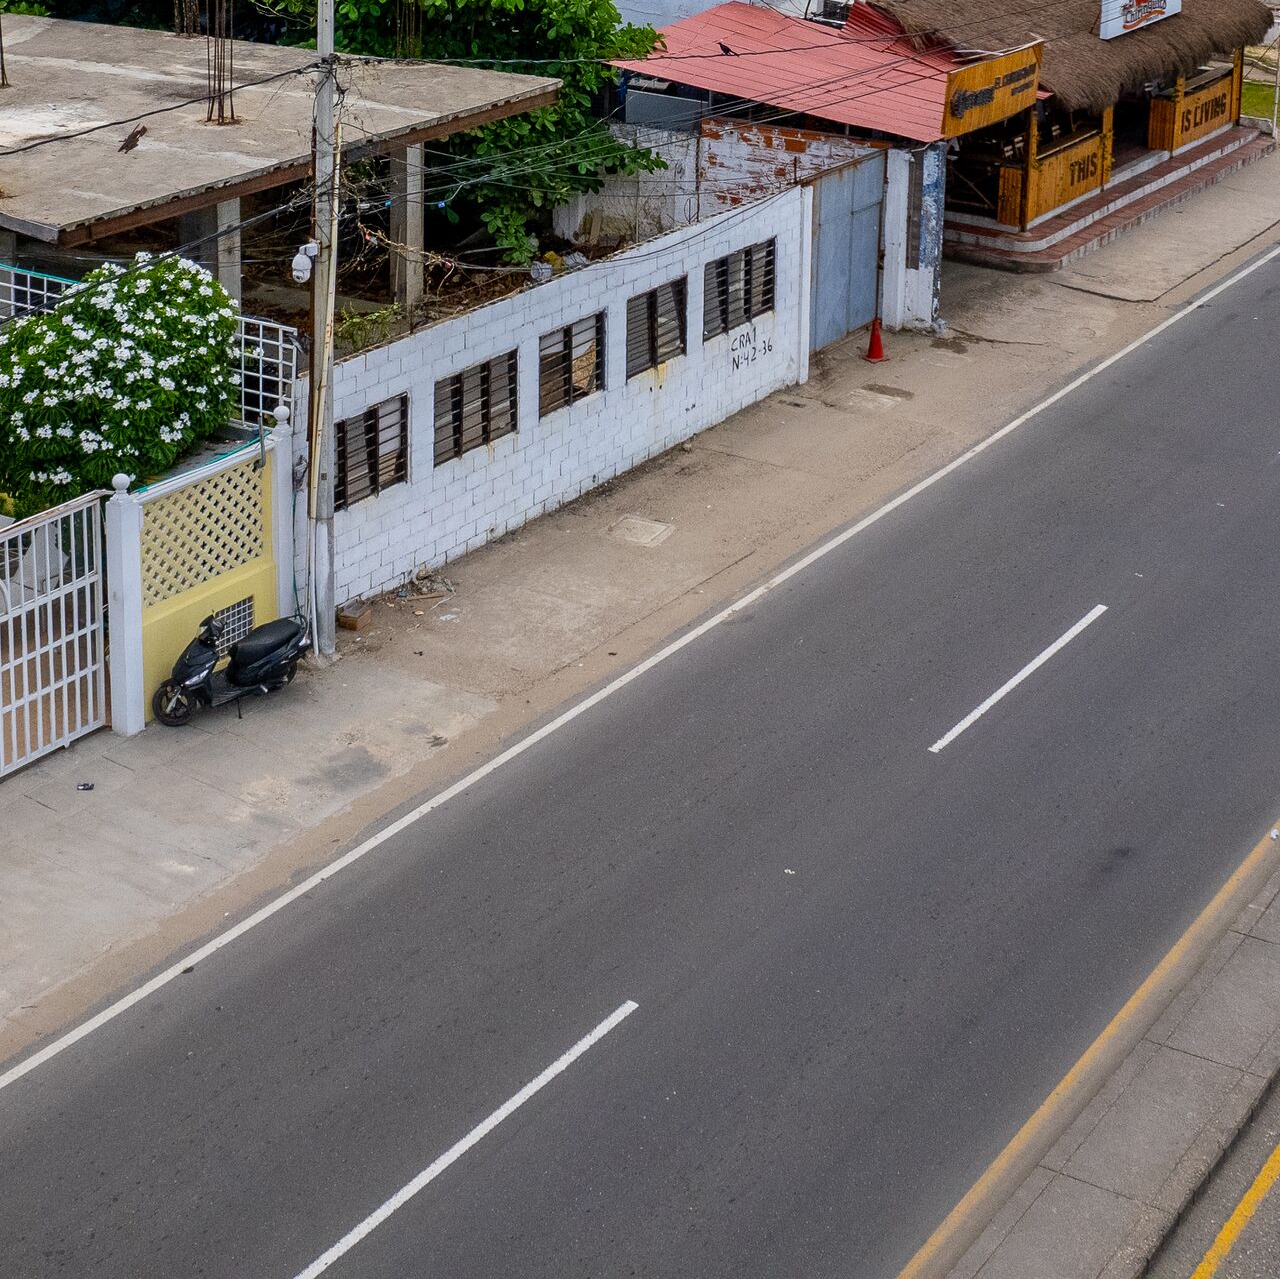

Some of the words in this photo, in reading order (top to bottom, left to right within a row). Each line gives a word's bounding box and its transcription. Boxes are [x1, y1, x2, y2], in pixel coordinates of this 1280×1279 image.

[1181, 109, 1191, 134] IS
[1193, 92, 1227, 128] LIVING
[1070, 152, 1098, 186] THIS
